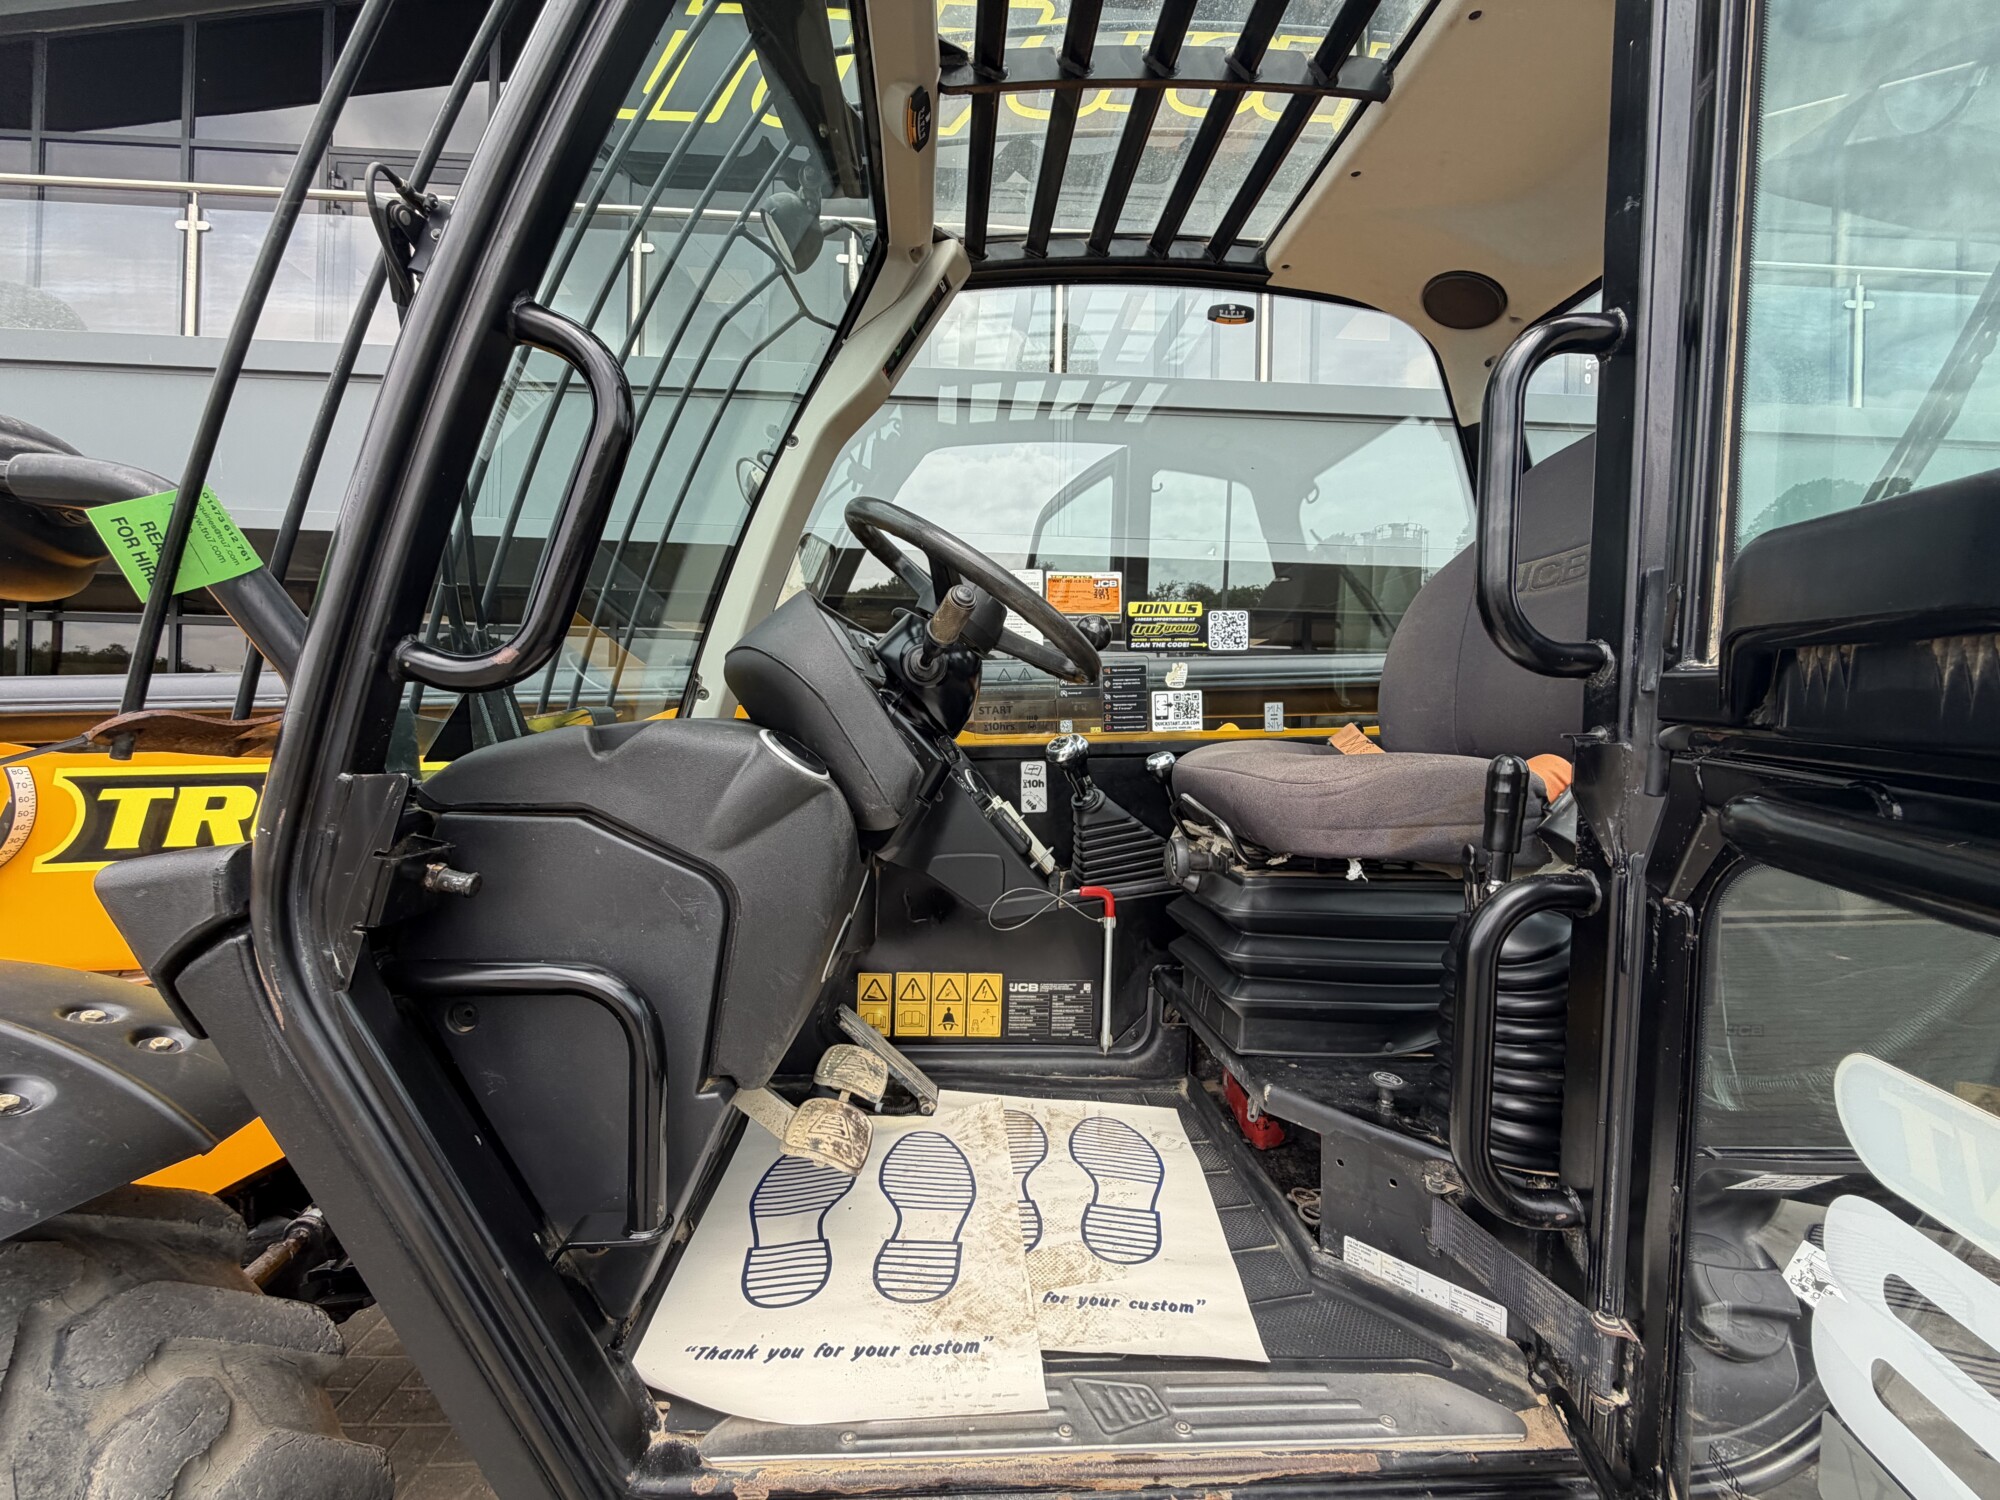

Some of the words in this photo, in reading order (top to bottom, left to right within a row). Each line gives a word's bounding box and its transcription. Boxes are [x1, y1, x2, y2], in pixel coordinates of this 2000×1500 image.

[110, 516, 141, 549] FOR
[198, 502, 240, 566] quiries@tru7.com
[203, 492, 225, 523] 01473
[223, 520, 239, 543] 612
[237, 543, 252, 562] 761
[193, 515, 227, 564] w.tru7.com
[1093, 580, 1118, 588] JCB
[1131, 604, 1172, 614] JOIN
[1175, 604, 1198, 614] US
[978, 705, 1014, 715] START
[17, 810, 29, 818] 50
[97, 785, 263, 849] TR
[1009, 982, 1039, 992] JCB
[1042, 1291, 1070, 1305] for
[1076, 1295, 1121, 1310] your
[684, 1344, 759, 1361] “Thank
[763, 1346, 805, 1364] you
[813, 1342, 845, 1358] for
[850, 1344, 900, 1362] your
